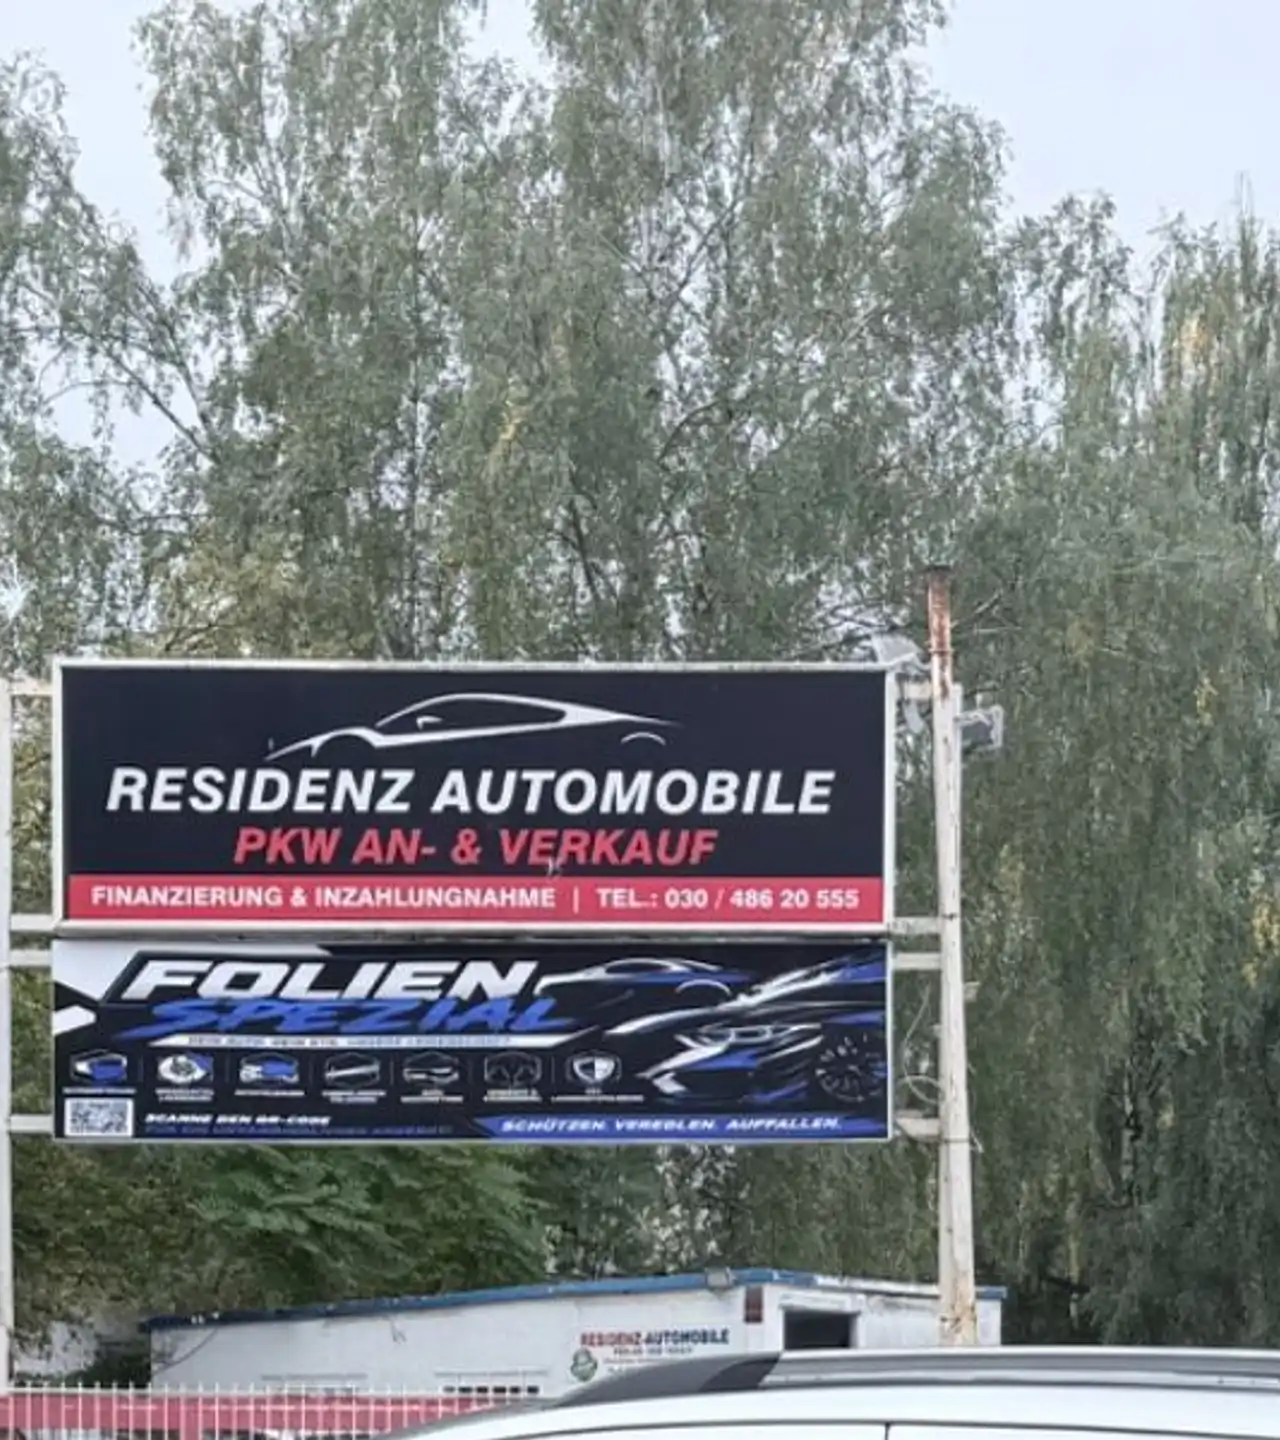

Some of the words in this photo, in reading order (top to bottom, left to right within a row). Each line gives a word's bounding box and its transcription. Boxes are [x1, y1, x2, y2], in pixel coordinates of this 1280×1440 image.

[106, 767, 415, 812] RESIDENZ
[431, 769, 835, 815] AUTOMOBILE
[233, 827, 342, 864] PKW
[351, 828, 437, 864] AN-
[450, 828, 482, 865] &
[499, 828, 719, 866] VERKAUF
[91, 885, 283, 907] FINANZIERUNG
[289, 886, 308, 907] &
[314, 886, 556, 909] INZAHLUNGNAHME
[596, 887, 658, 909] TEL.:
[663, 888, 707, 909] 030
[729, 888, 774, 909] 486
[780, 888, 811, 909] 20
[816, 888, 860, 909] 555
[122, 960, 538, 1000] FOLIEN
[115, 998, 573, 1042] SPEZIAL
